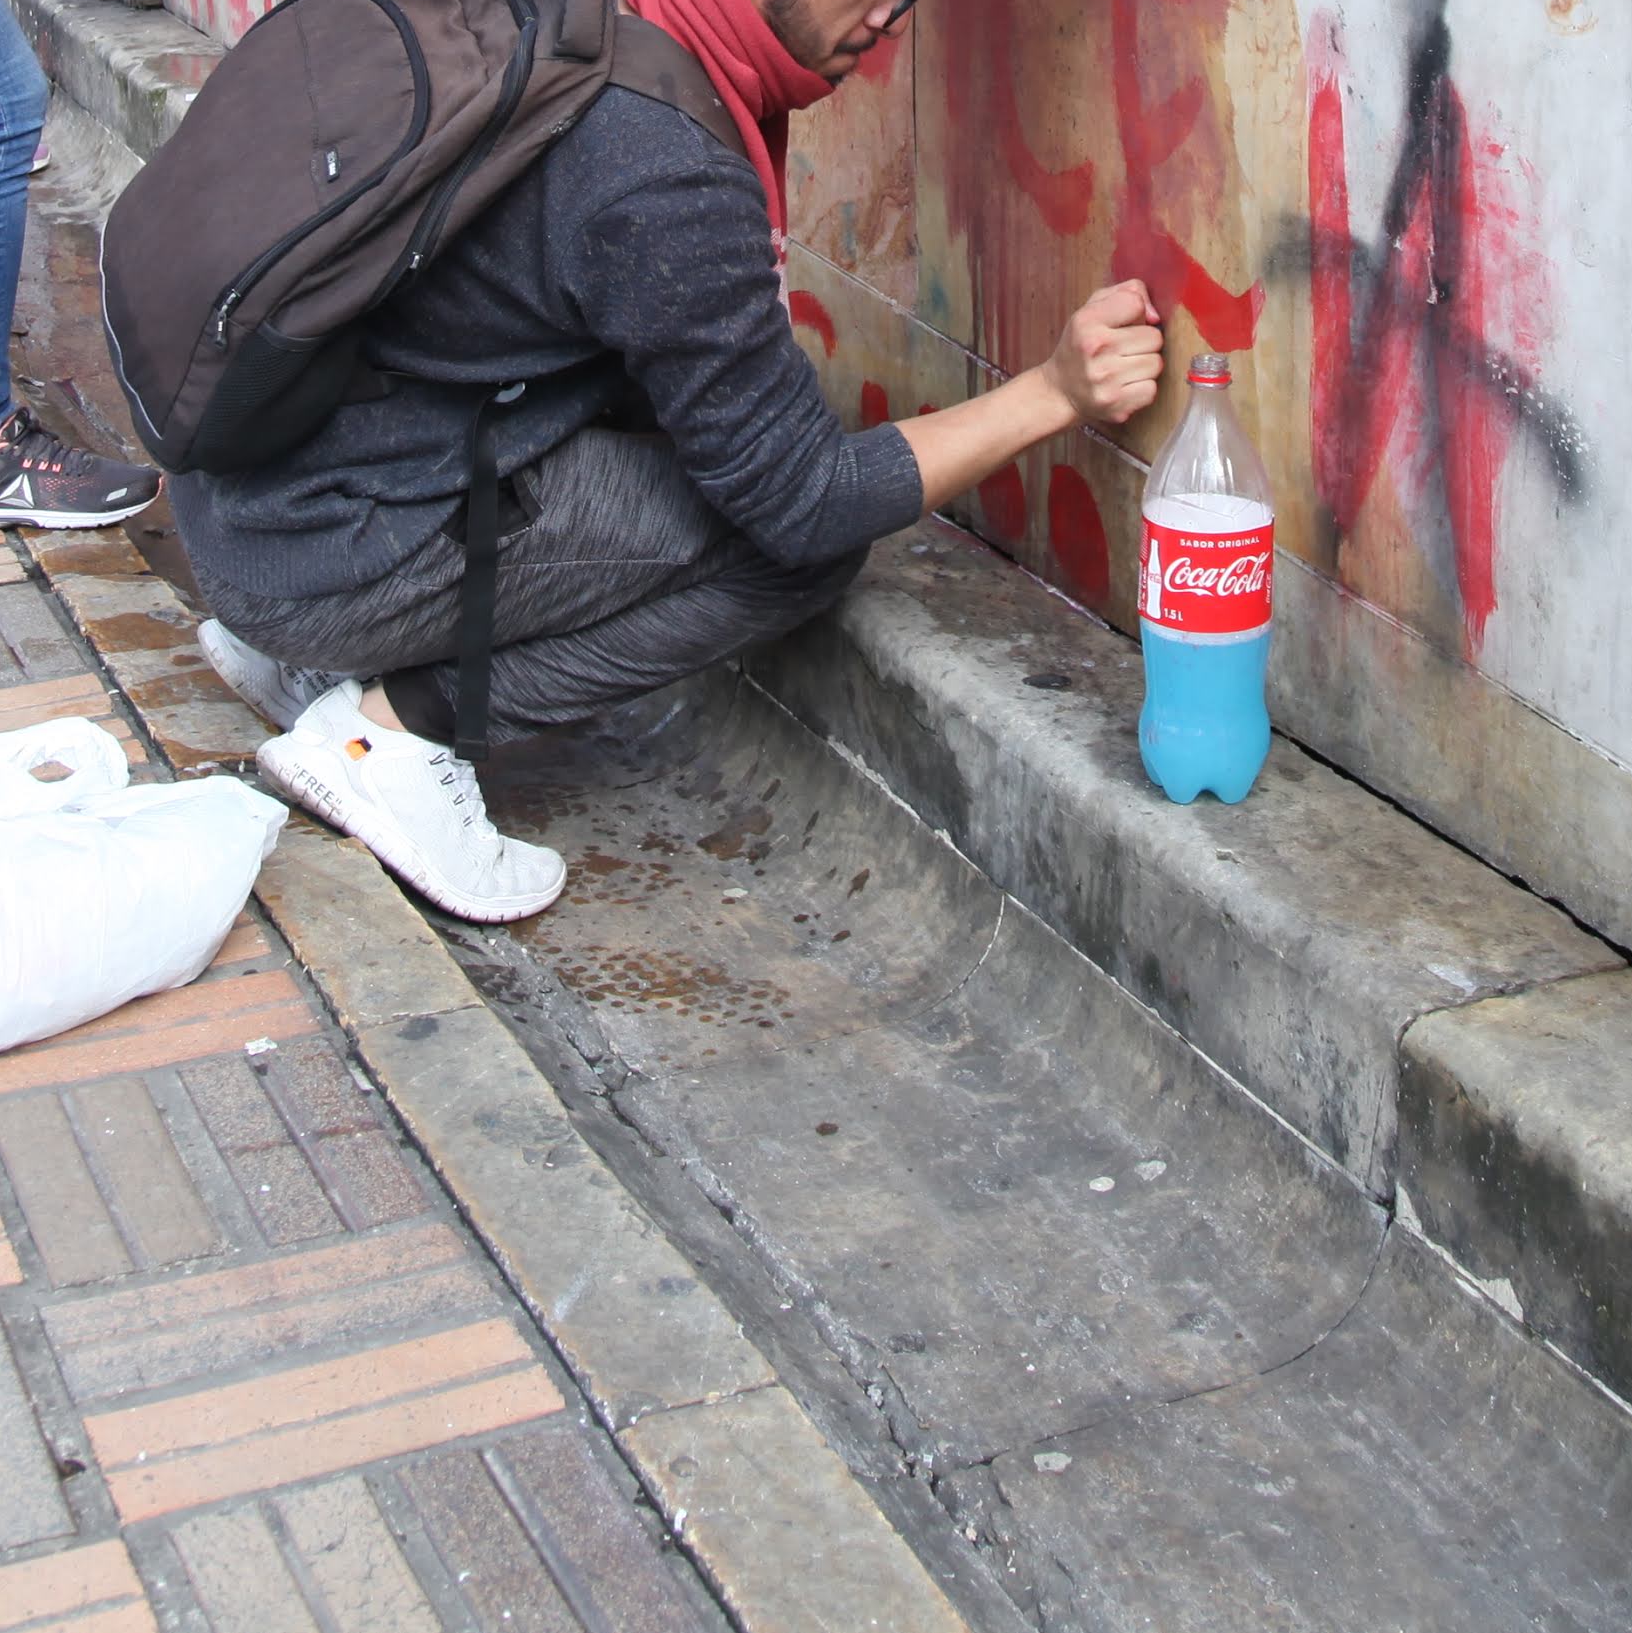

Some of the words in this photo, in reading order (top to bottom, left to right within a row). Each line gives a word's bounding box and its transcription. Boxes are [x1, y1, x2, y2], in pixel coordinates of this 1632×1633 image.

[1180, 538, 1214, 549] SABOR
[1217, 536, 1260, 548] ORIGINAL
[1164, 551, 1270, 597] Coca-Cola
